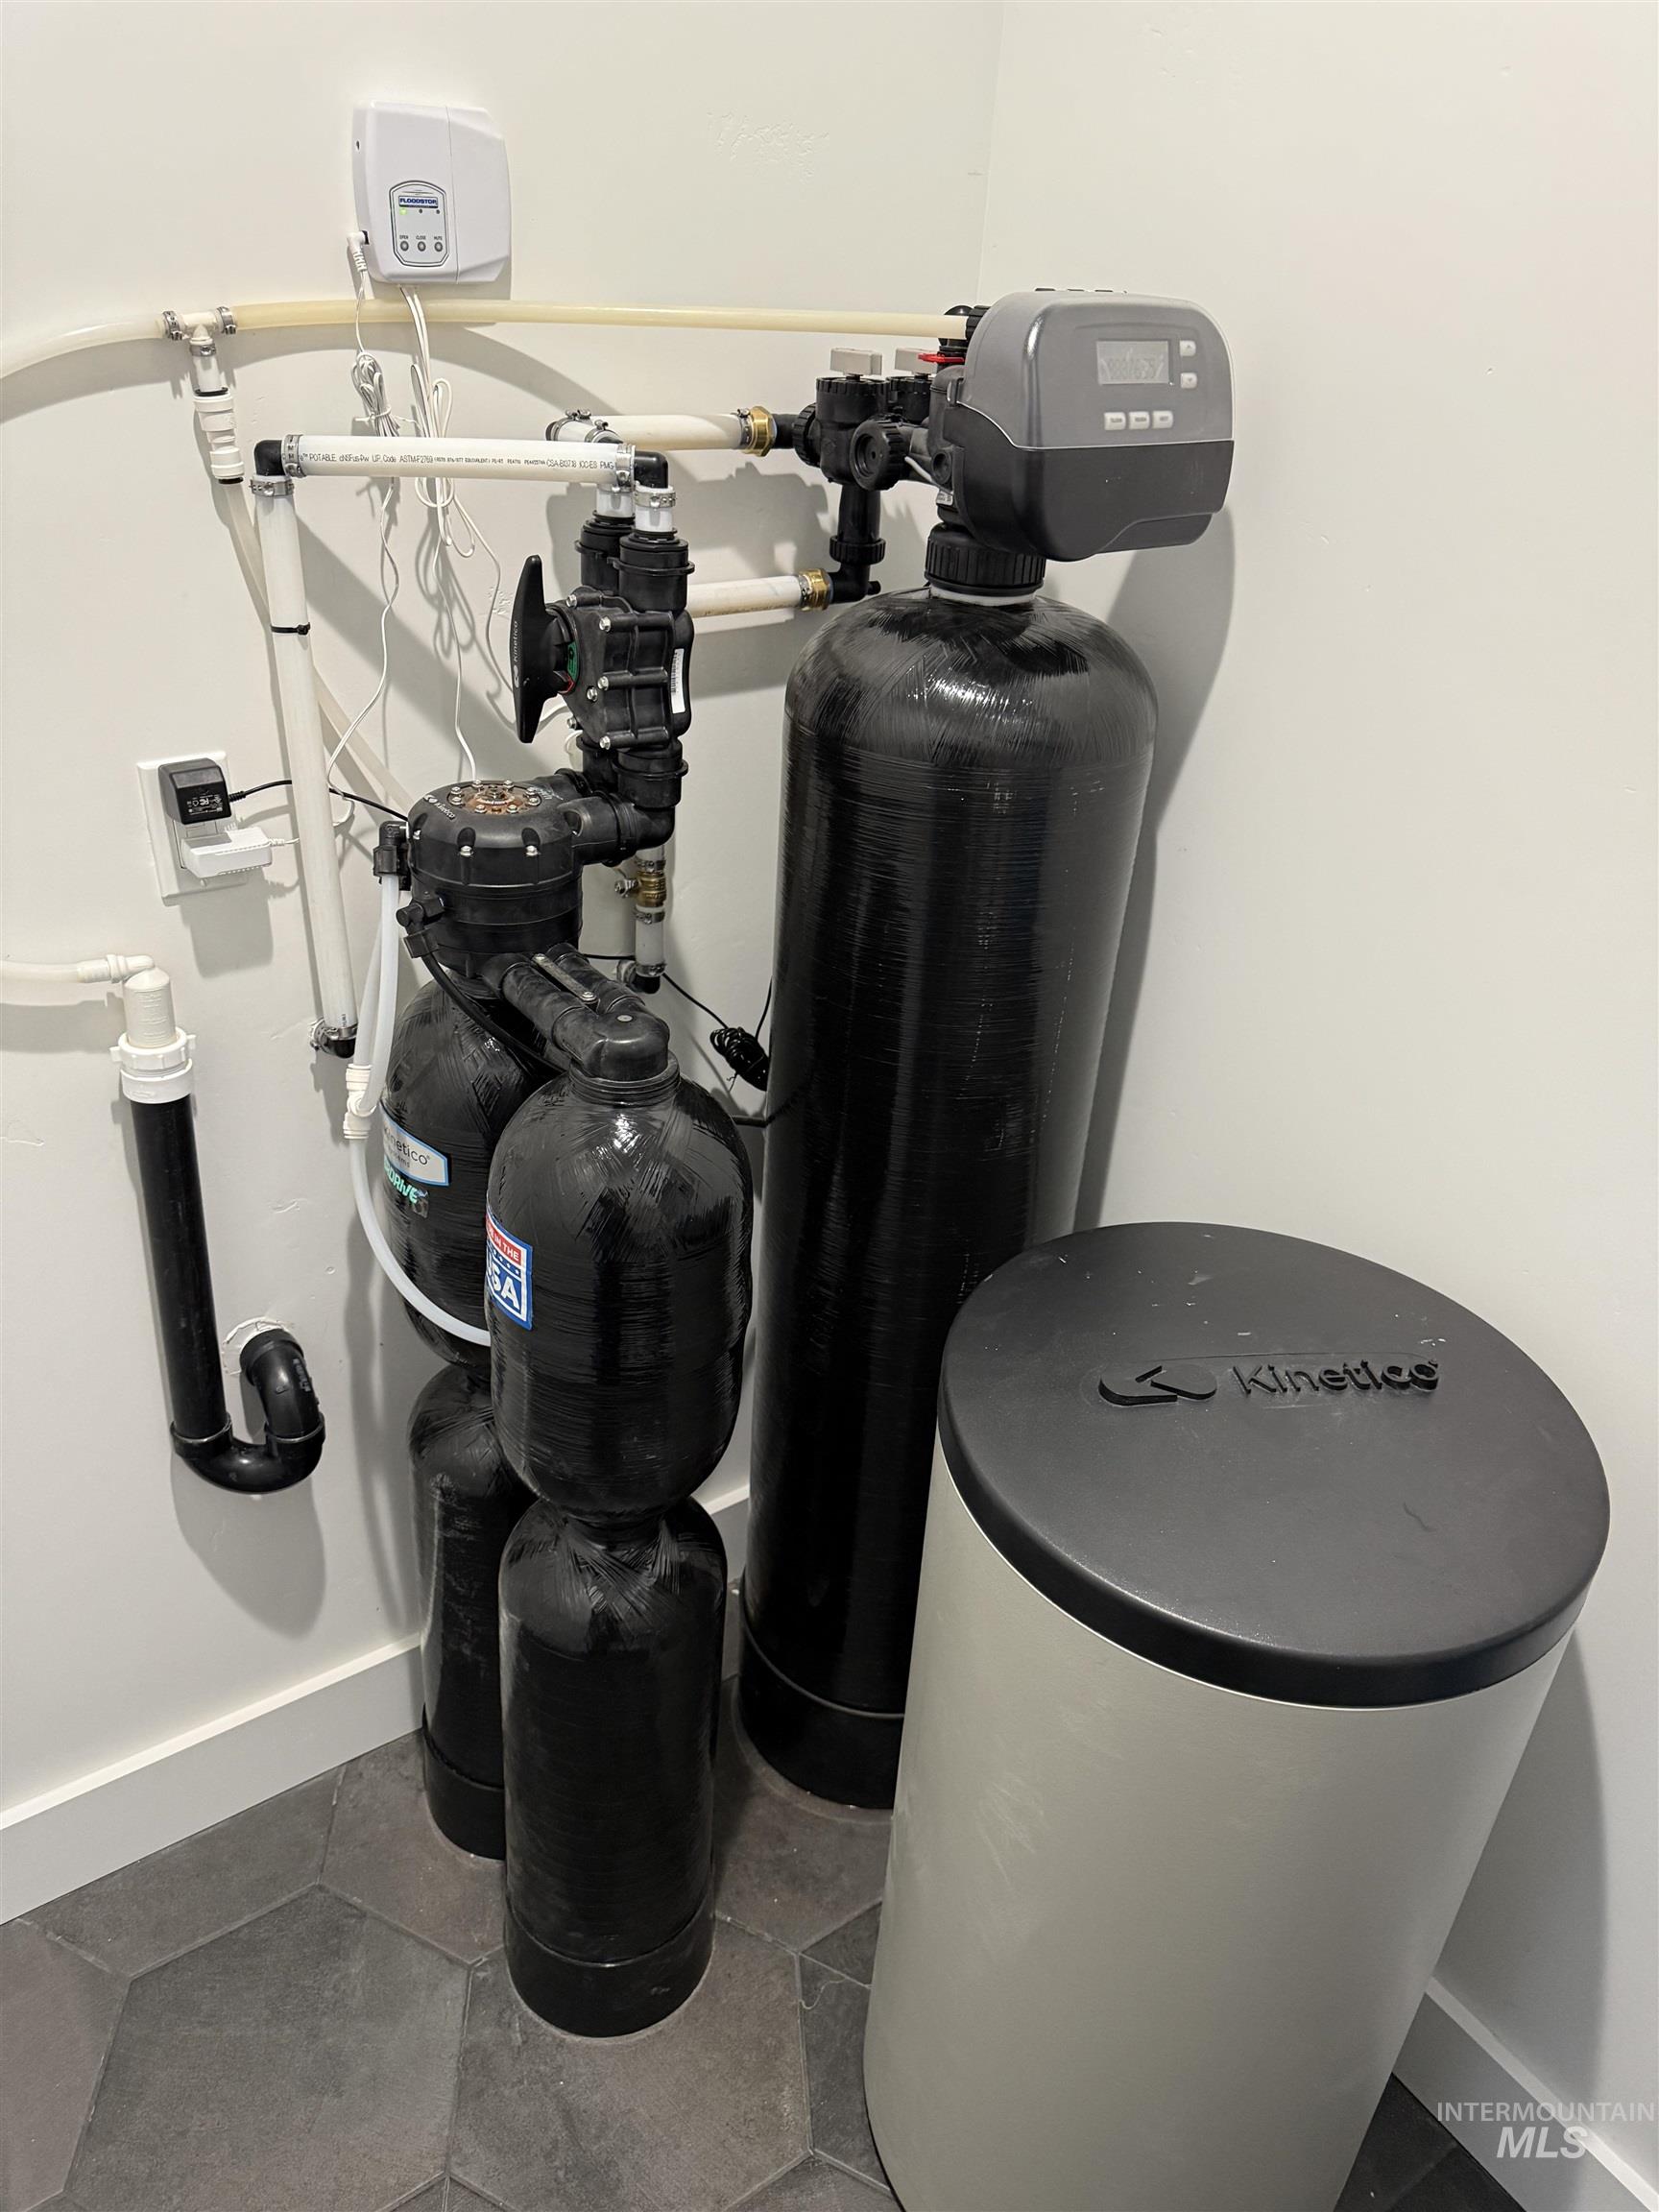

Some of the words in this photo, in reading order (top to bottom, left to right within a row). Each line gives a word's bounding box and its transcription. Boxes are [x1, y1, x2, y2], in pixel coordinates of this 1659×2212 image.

[309, 453, 336, 462] POTABLE
[502, 1242, 519, 1262] THE
[1232, 1359, 1438, 1393] Kinetico
